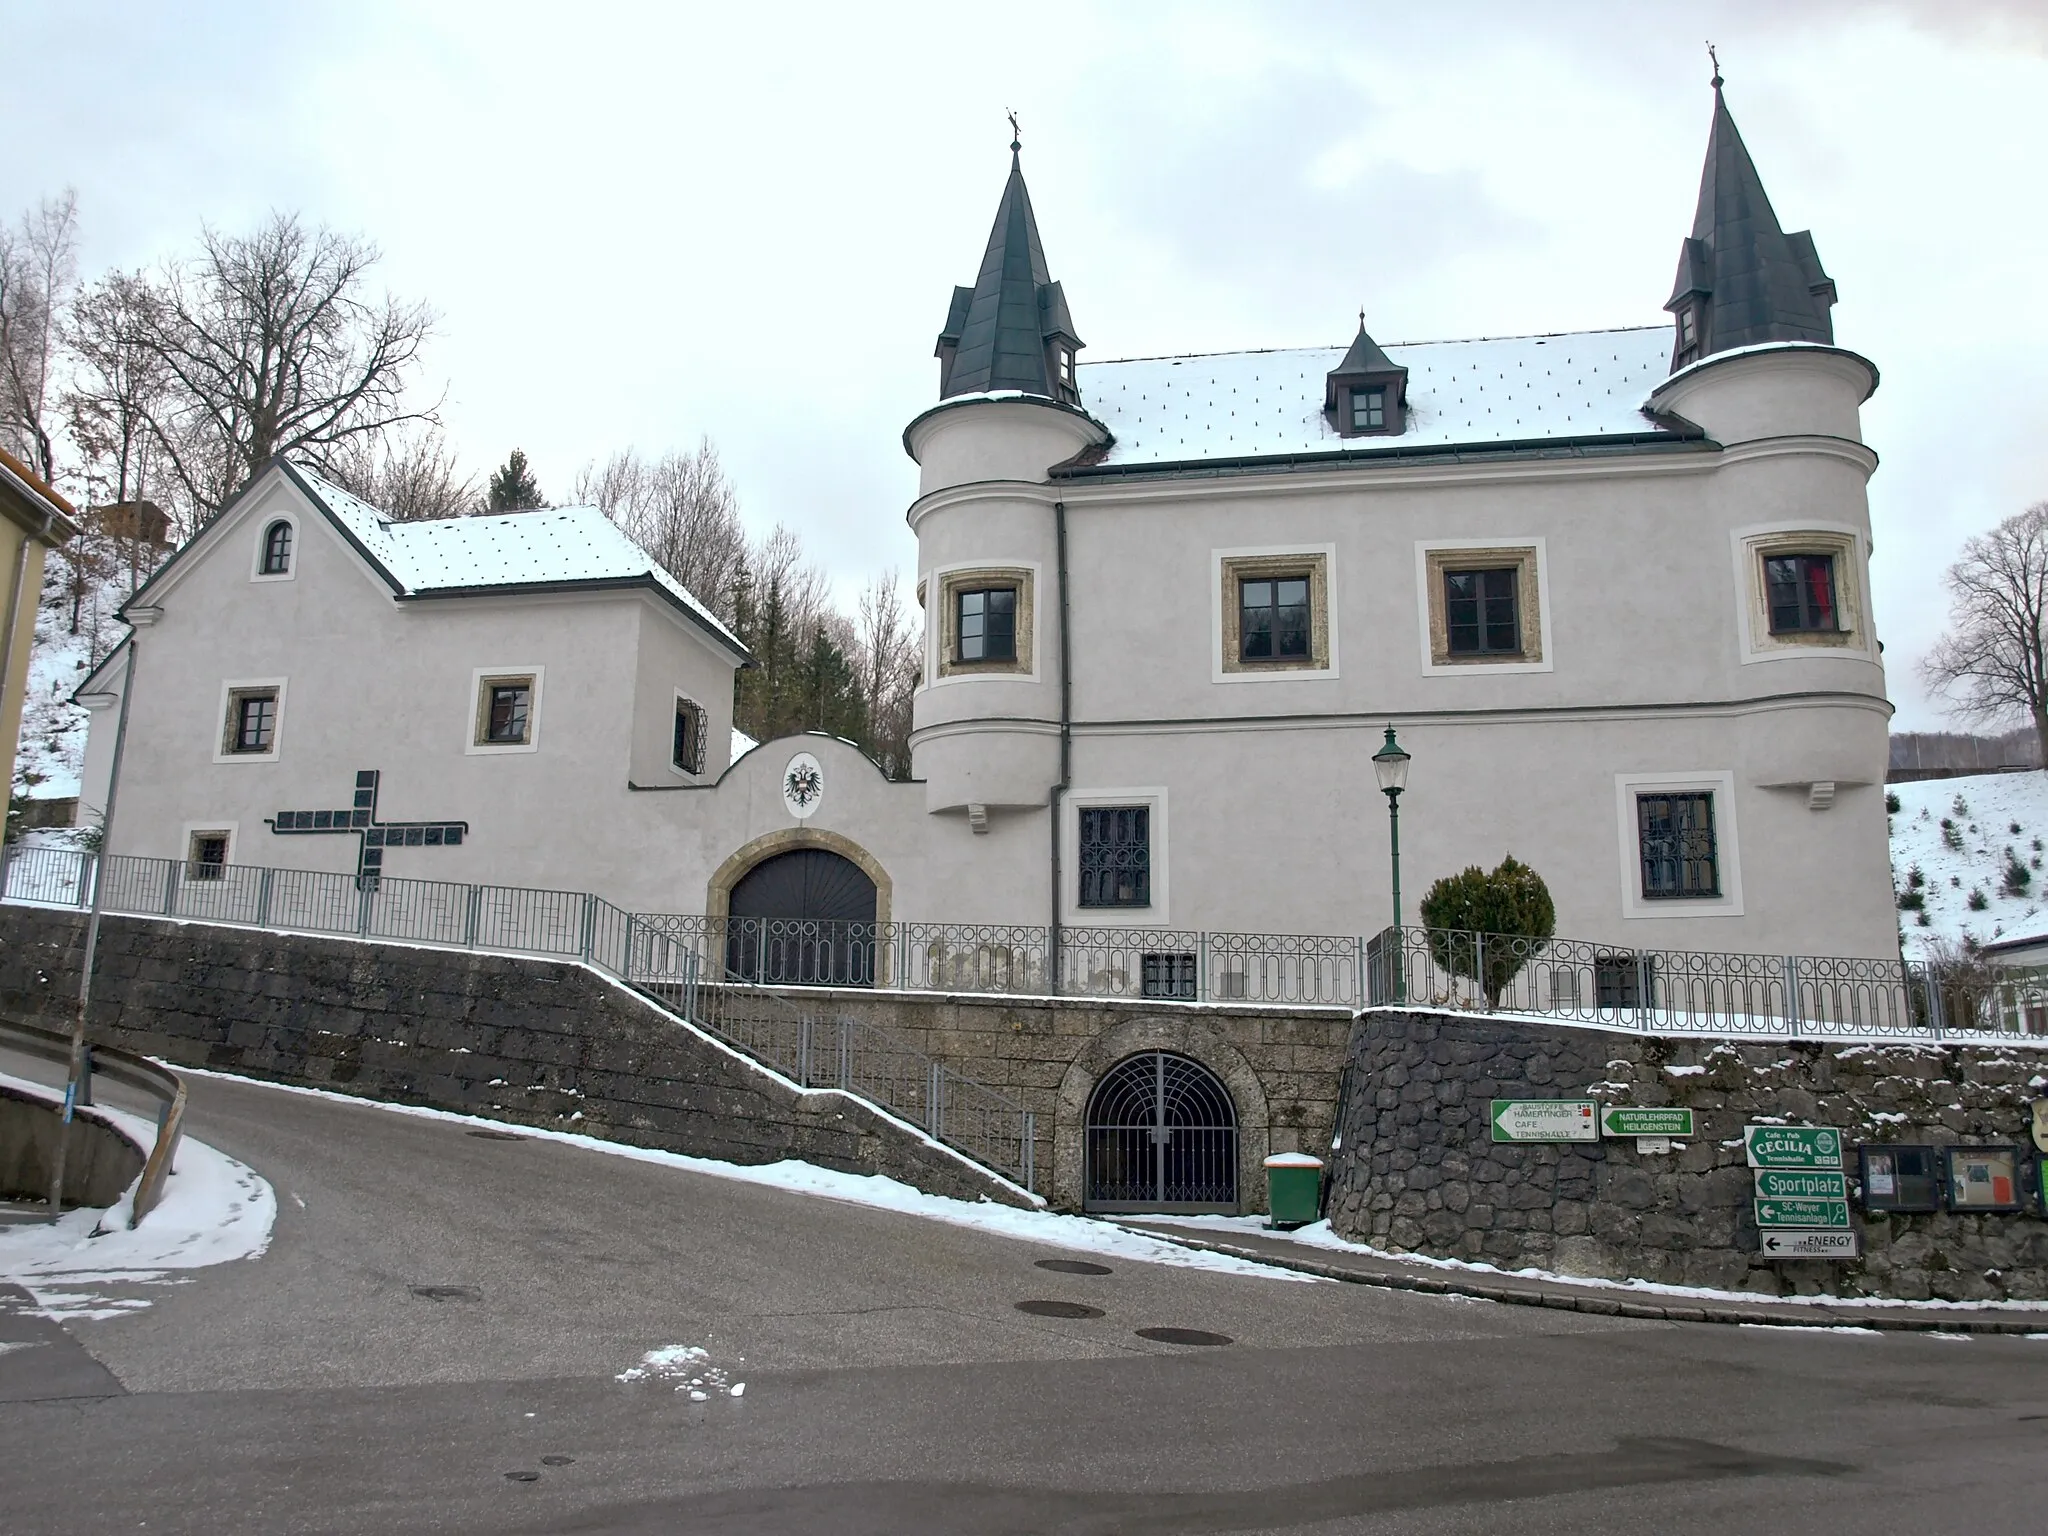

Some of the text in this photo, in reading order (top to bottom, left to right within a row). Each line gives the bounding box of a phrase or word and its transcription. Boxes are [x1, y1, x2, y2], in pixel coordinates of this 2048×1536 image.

[1514, 1110, 1573, 1118] HAMERTINGER
[1619, 1112, 1684, 1122] NATURLEHRPFAD
[1623, 1122, 1681, 1131] HEILIGENSTEIN
[1756, 1140, 1812, 1155] CECILIA
[1768, 1175, 1840, 1195] Sportplatz
[1782, 1202, 1820, 1211] SC-Weyer
[1776, 1212, 1828, 1224] Tennisanlage
[1807, 1235, 1852, 1246] ENERGY
